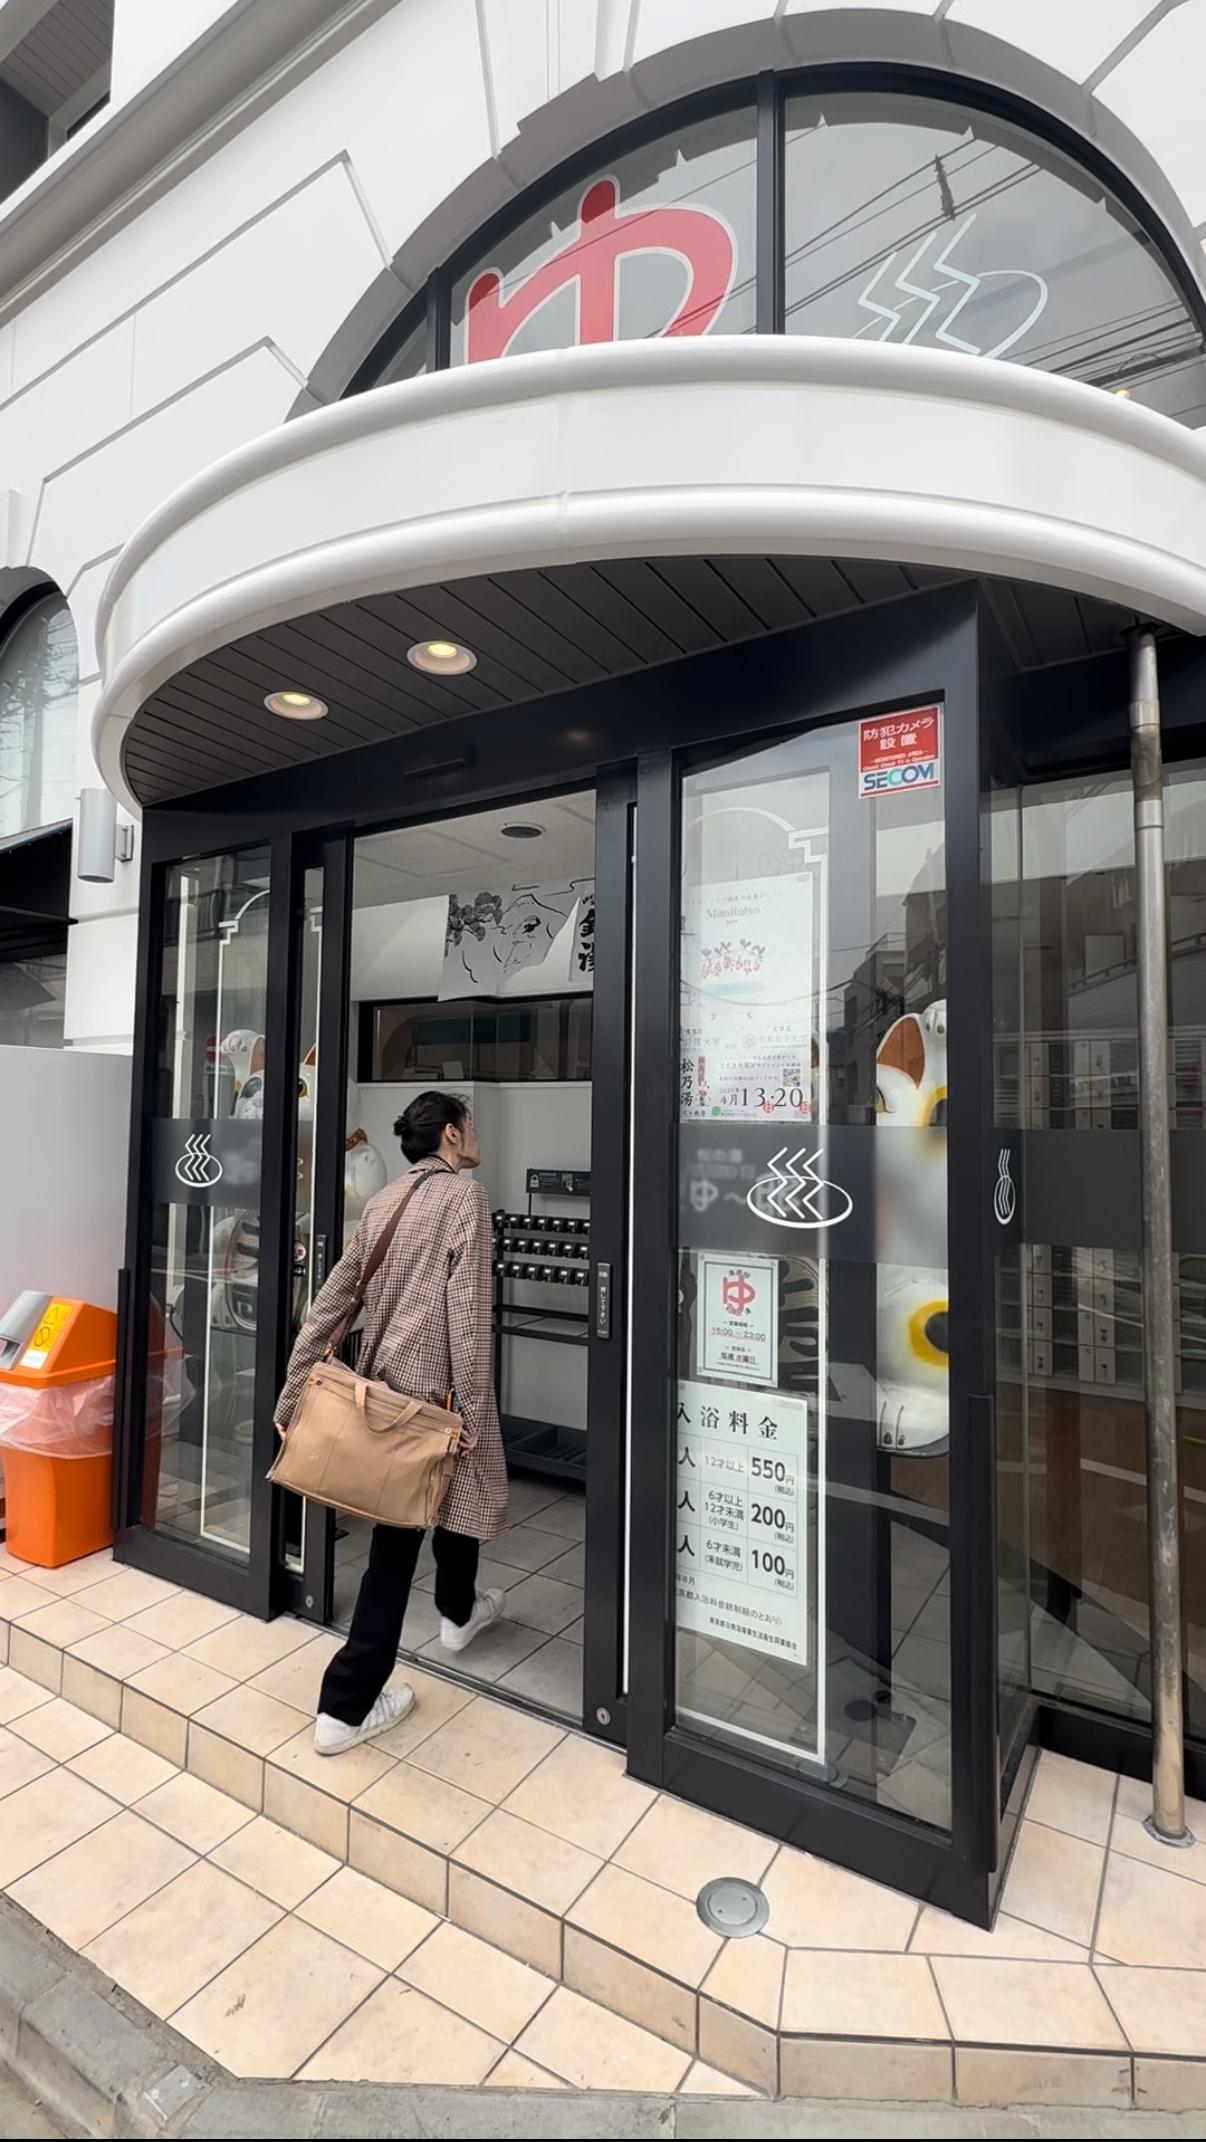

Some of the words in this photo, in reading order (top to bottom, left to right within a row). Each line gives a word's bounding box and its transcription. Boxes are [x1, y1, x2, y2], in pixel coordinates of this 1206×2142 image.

[863, 717, 934, 741] 防犯カメラ
[880, 733, 917, 750] 設置
[864, 763, 934, 790] SECOM
[680, 1058, 695, 1107] 松乃湯
[722, 1273, 756, 1316] ゆ
[677, 1402, 779, 1441] 入浴料金
[705, 1456, 744, 1473] 12才以上
[709, 1490, 743, 1508] 6才以上
[705, 1502, 744, 1521] 12才未満
[706, 1540, 741, 1557] 6才未満
